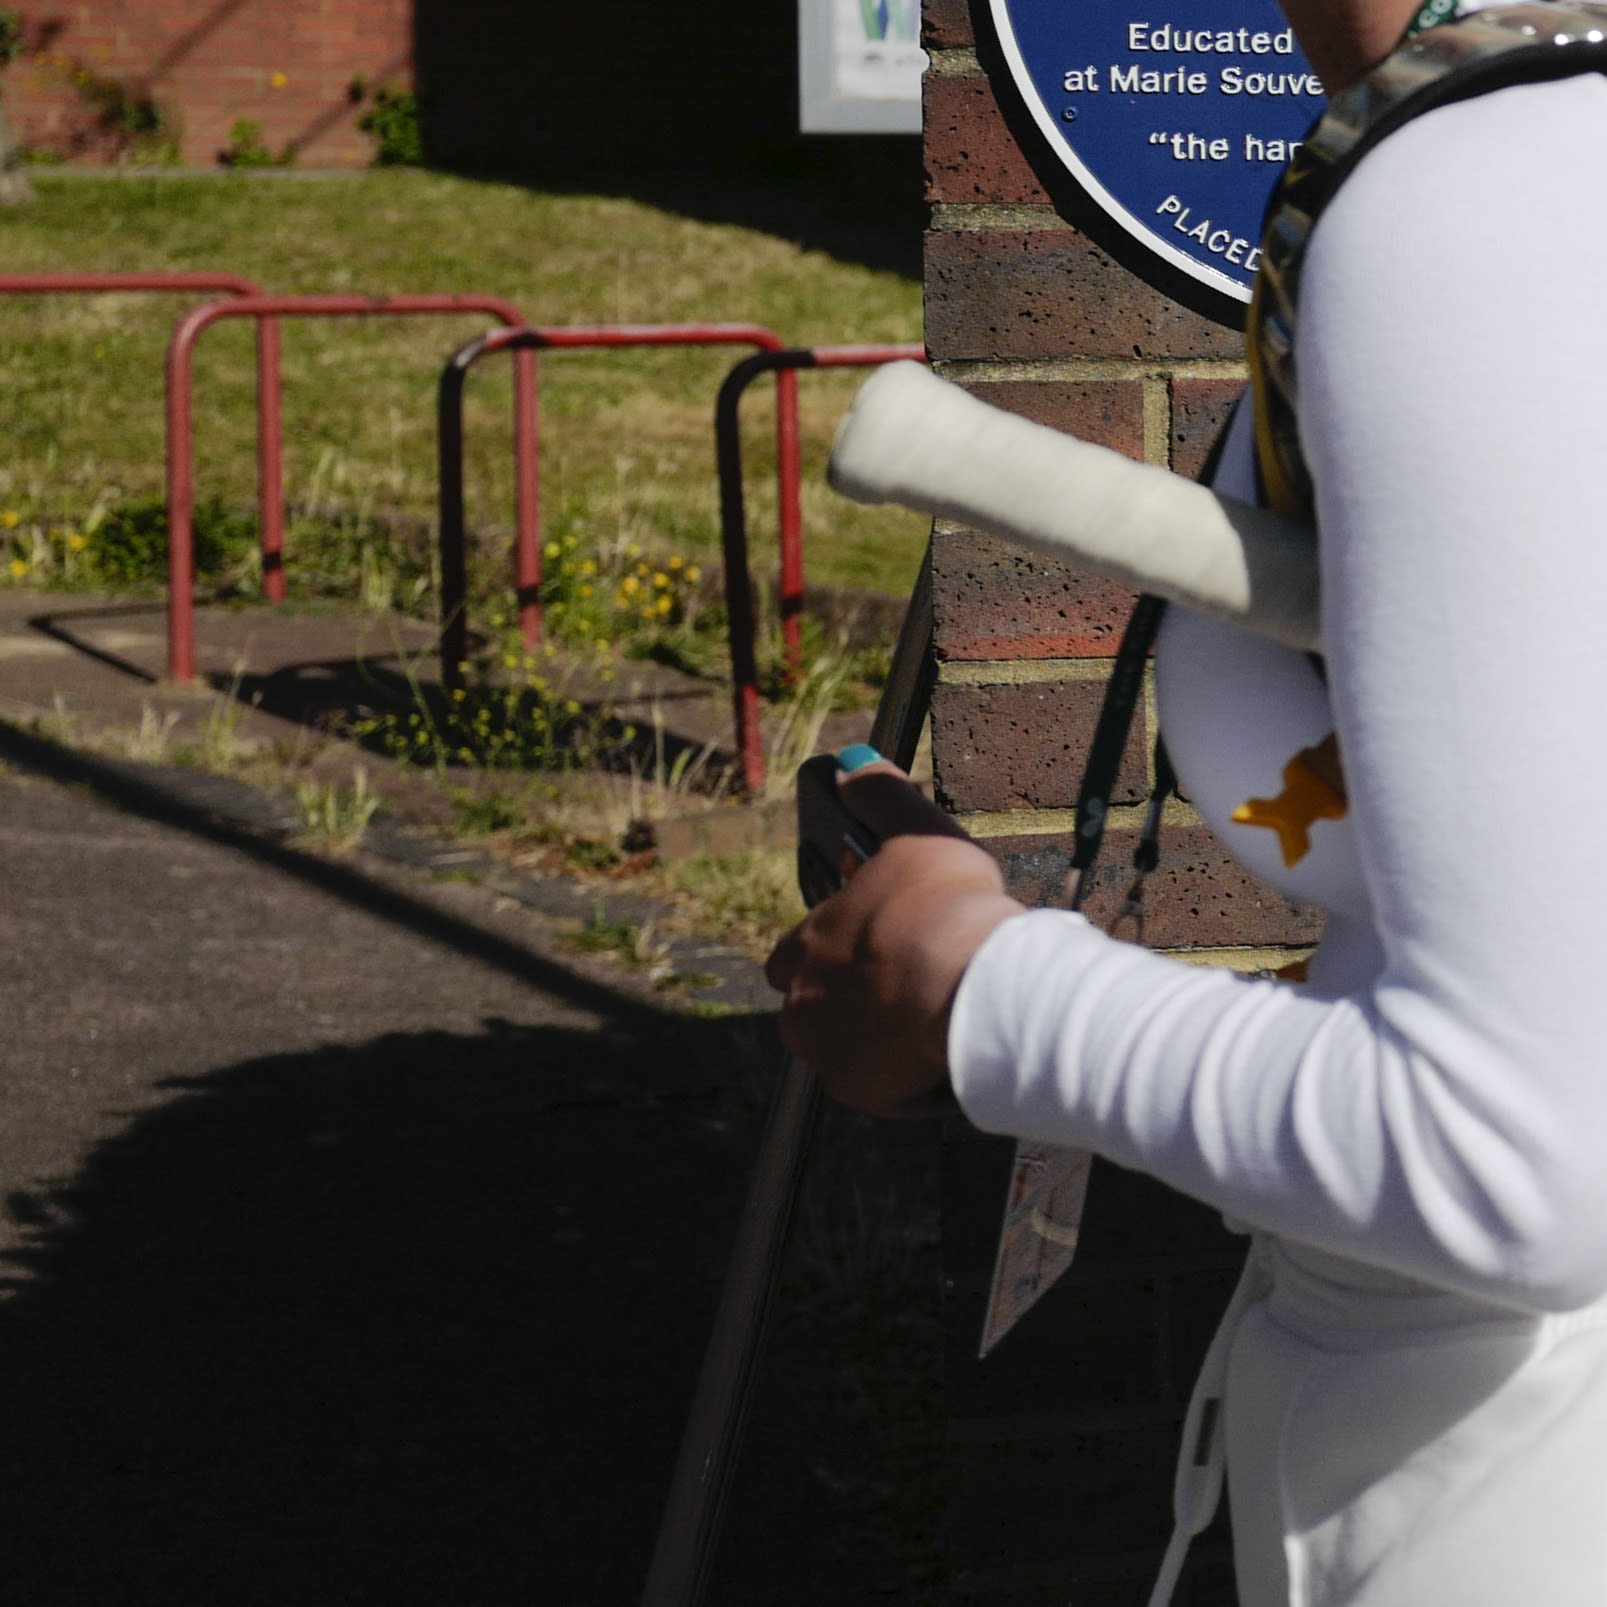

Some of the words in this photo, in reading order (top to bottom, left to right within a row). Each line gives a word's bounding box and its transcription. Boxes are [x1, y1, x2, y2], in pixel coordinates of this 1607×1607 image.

[1128, 22, 1293, 54] Educated
[1063, 64, 1099, 92] at
[1110, 65, 1207, 94] Marie
[1220, 66, 1325, 96] Souve
[1149, 131, 1229, 161] “the
[1156, 195, 1264, 272] PLACED
